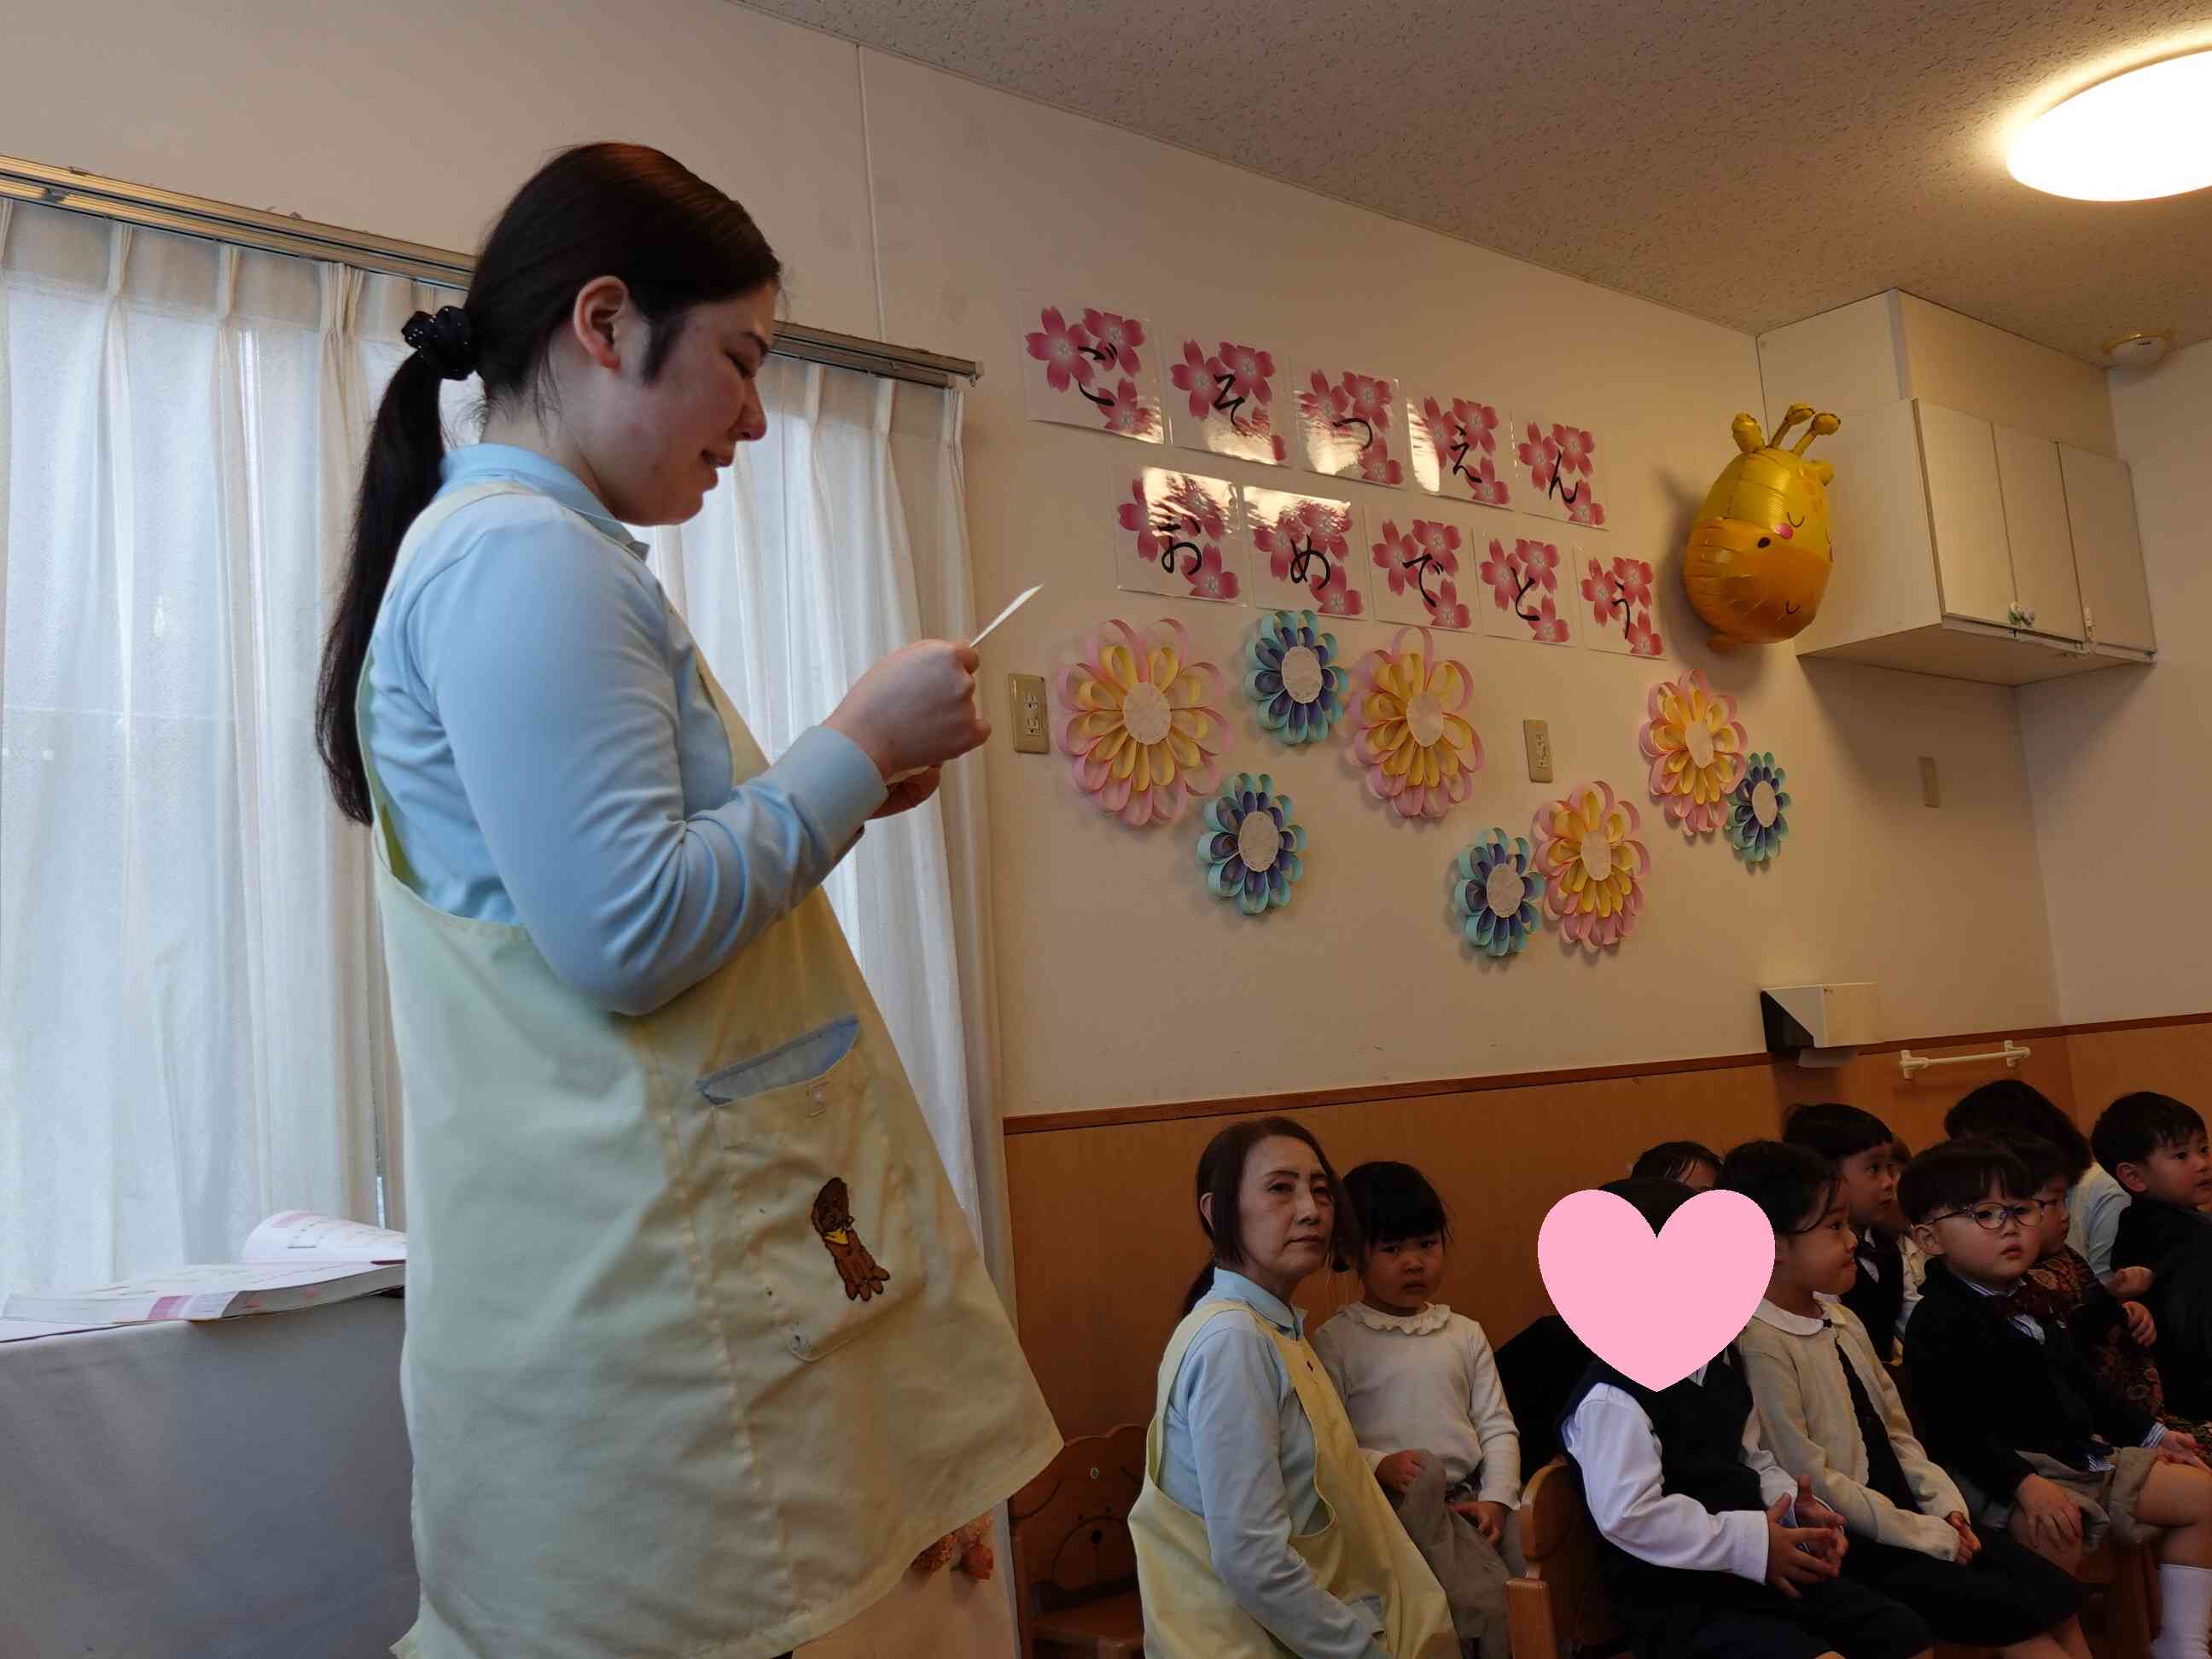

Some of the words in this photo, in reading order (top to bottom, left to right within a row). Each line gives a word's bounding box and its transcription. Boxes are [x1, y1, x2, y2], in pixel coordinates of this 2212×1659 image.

[1160, 511, 1631, 640] おめでとう
